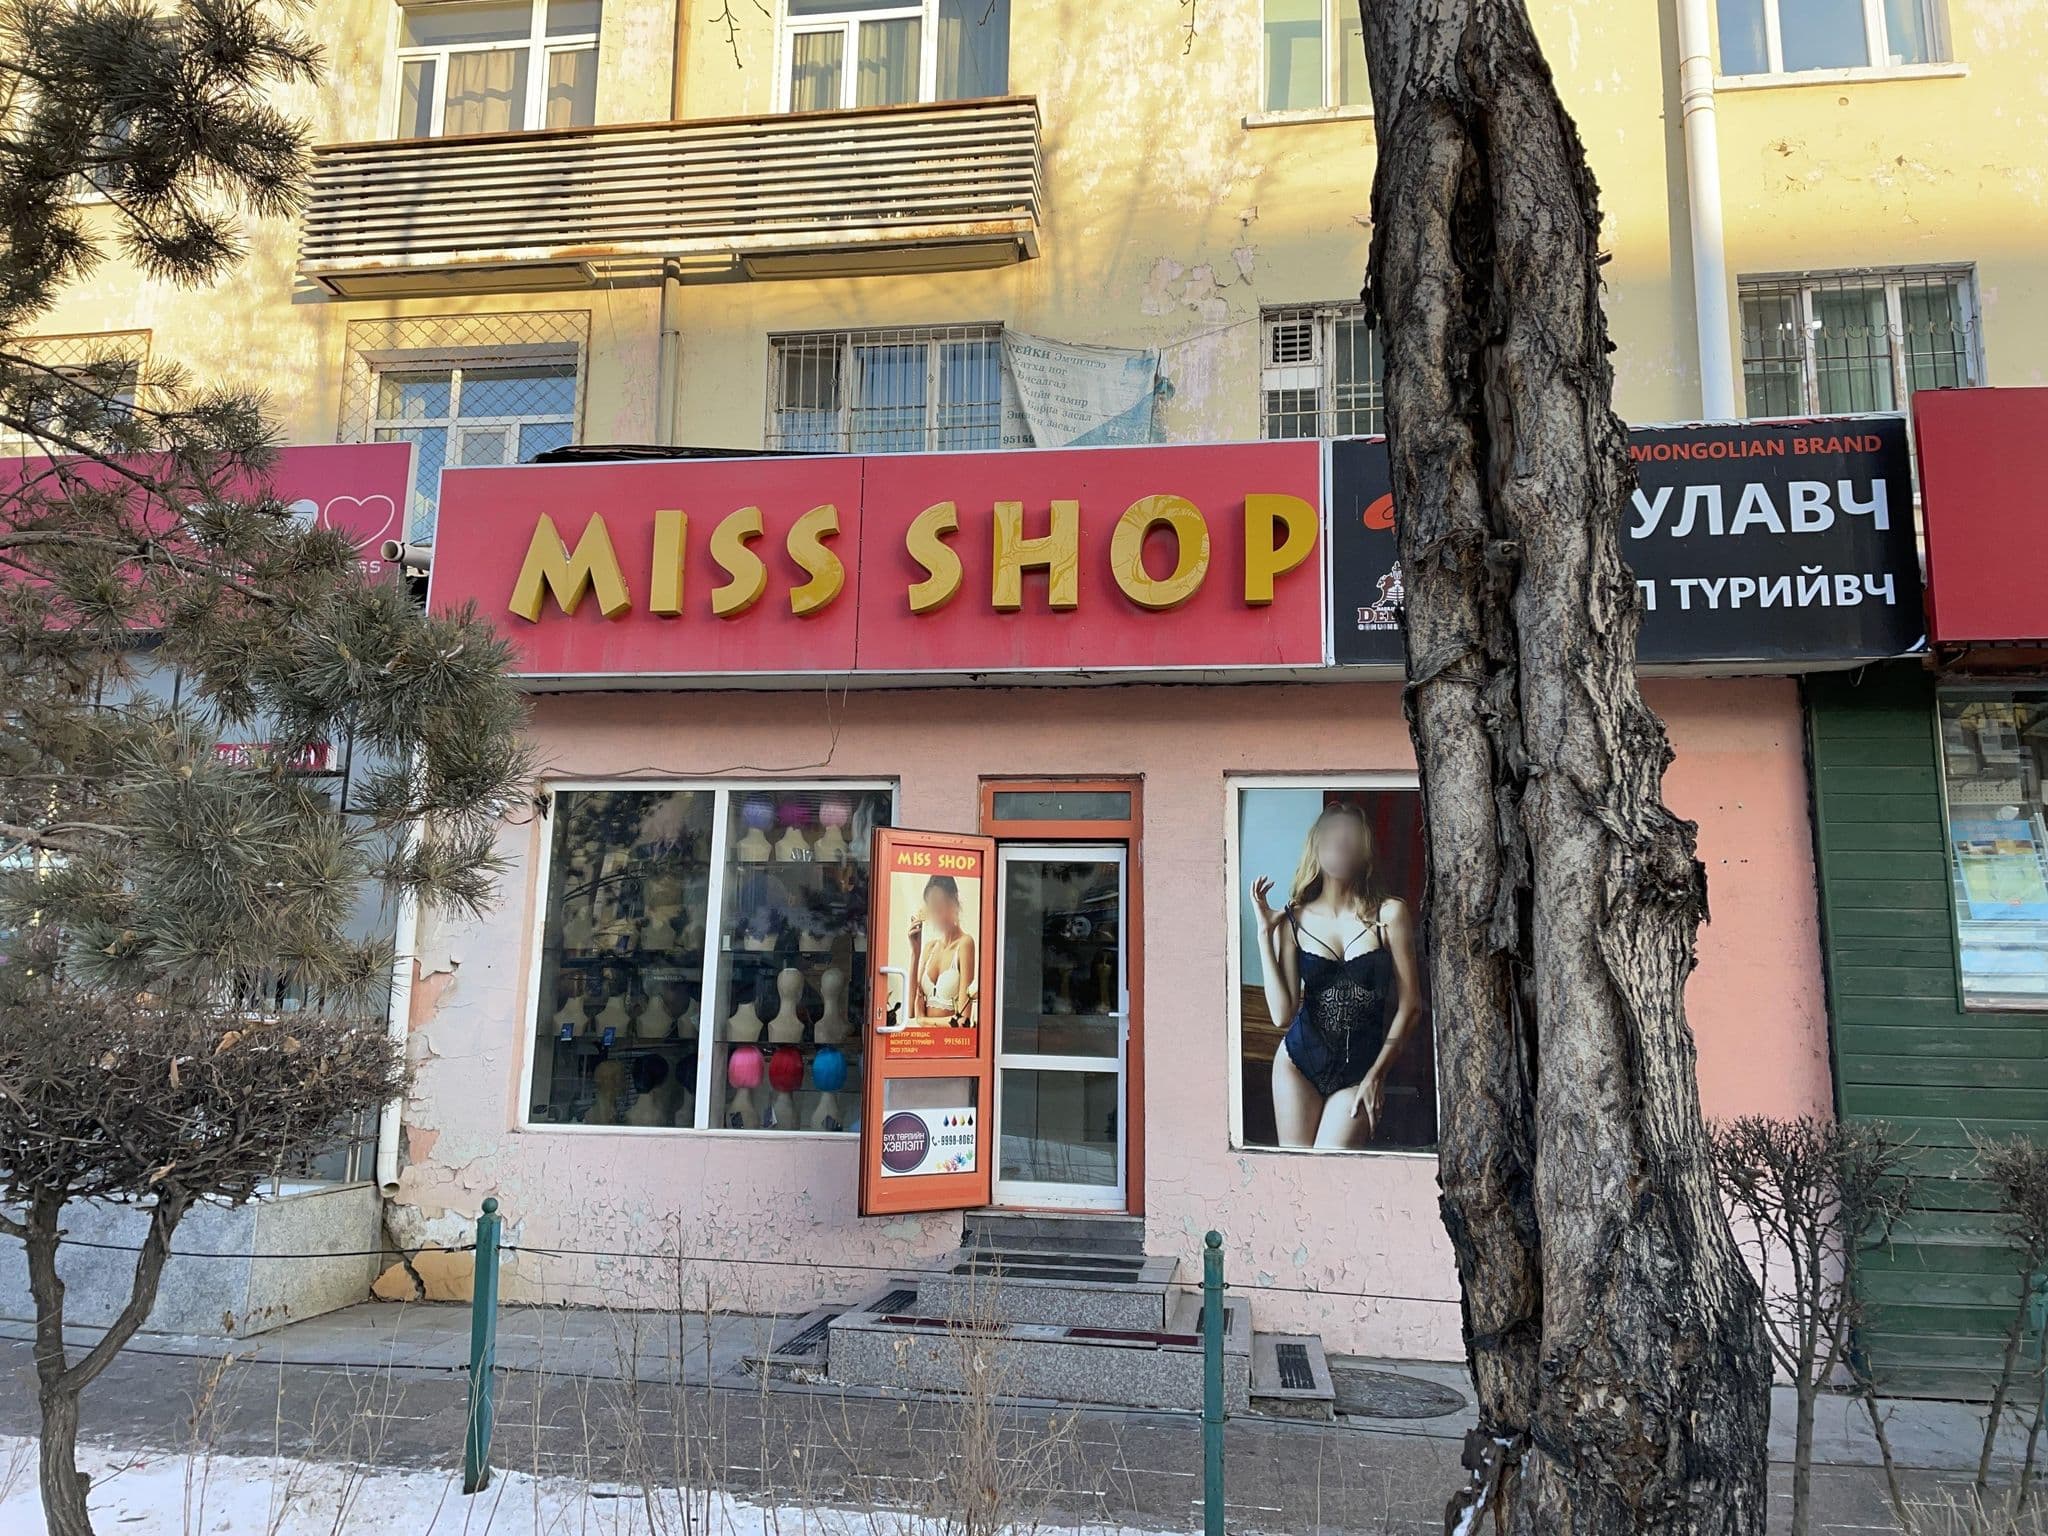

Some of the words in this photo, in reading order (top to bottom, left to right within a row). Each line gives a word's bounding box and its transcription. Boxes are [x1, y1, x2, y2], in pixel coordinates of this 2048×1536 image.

[1630, 439, 1785, 463] MONGOLIAN
[1793, 435, 1883, 456] BRAND
[1630, 479, 1890, 540] УЛАВЧ
[509, 504, 845, 624] MISS
[906, 493, 1319, 614] SHOP
[1670, 565, 1897, 611] ТҮРИЙВЧ
[897, 851, 932, 867] MISS
[938, 854, 976, 870] SHOP
[882, 1140, 925, 1153] ХЭВЛЭЛТ
